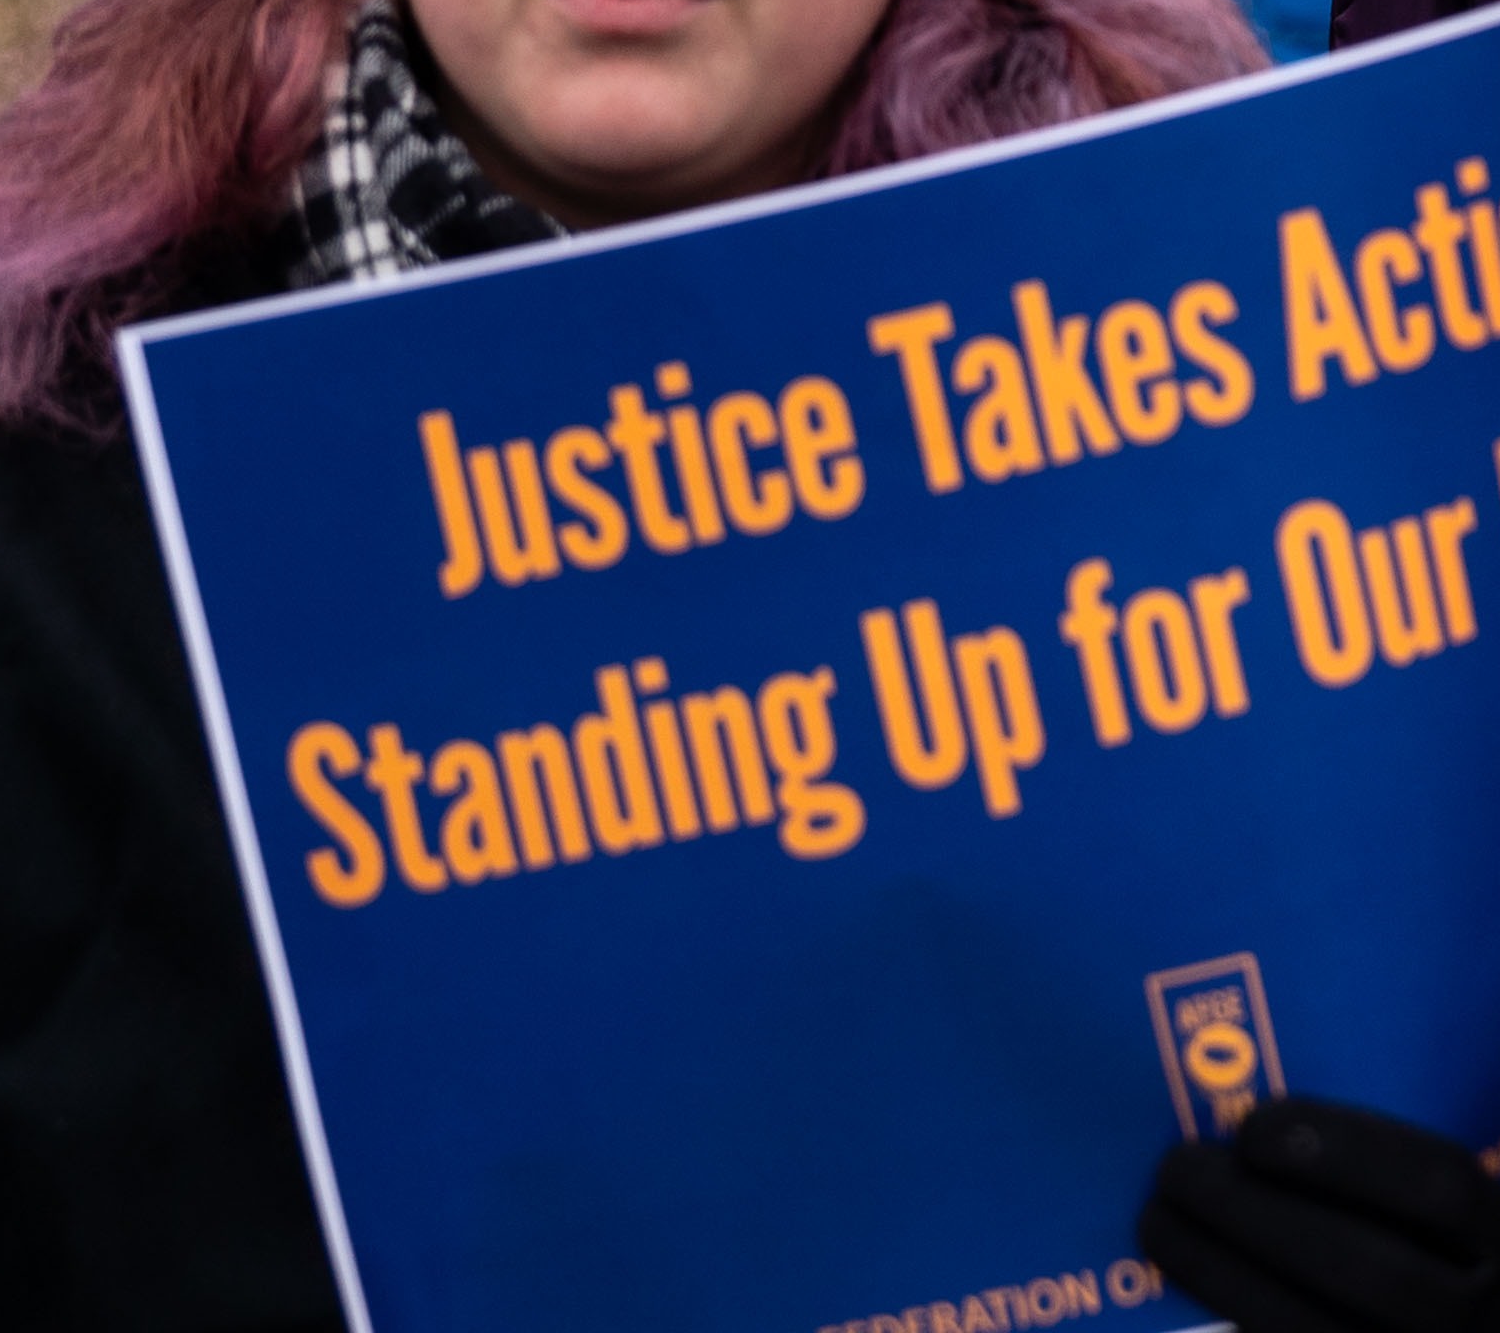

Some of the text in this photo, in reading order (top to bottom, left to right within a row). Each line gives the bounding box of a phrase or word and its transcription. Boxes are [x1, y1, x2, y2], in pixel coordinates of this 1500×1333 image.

[421, 364, 863, 595] Justice
[870, 283, 1252, 491] Takes
[290, 659, 864, 904] Standing
[863, 601, 1043, 815] Up
[1062, 561, 1247, 744] for
[1279, 501, 1475, 684] Our
